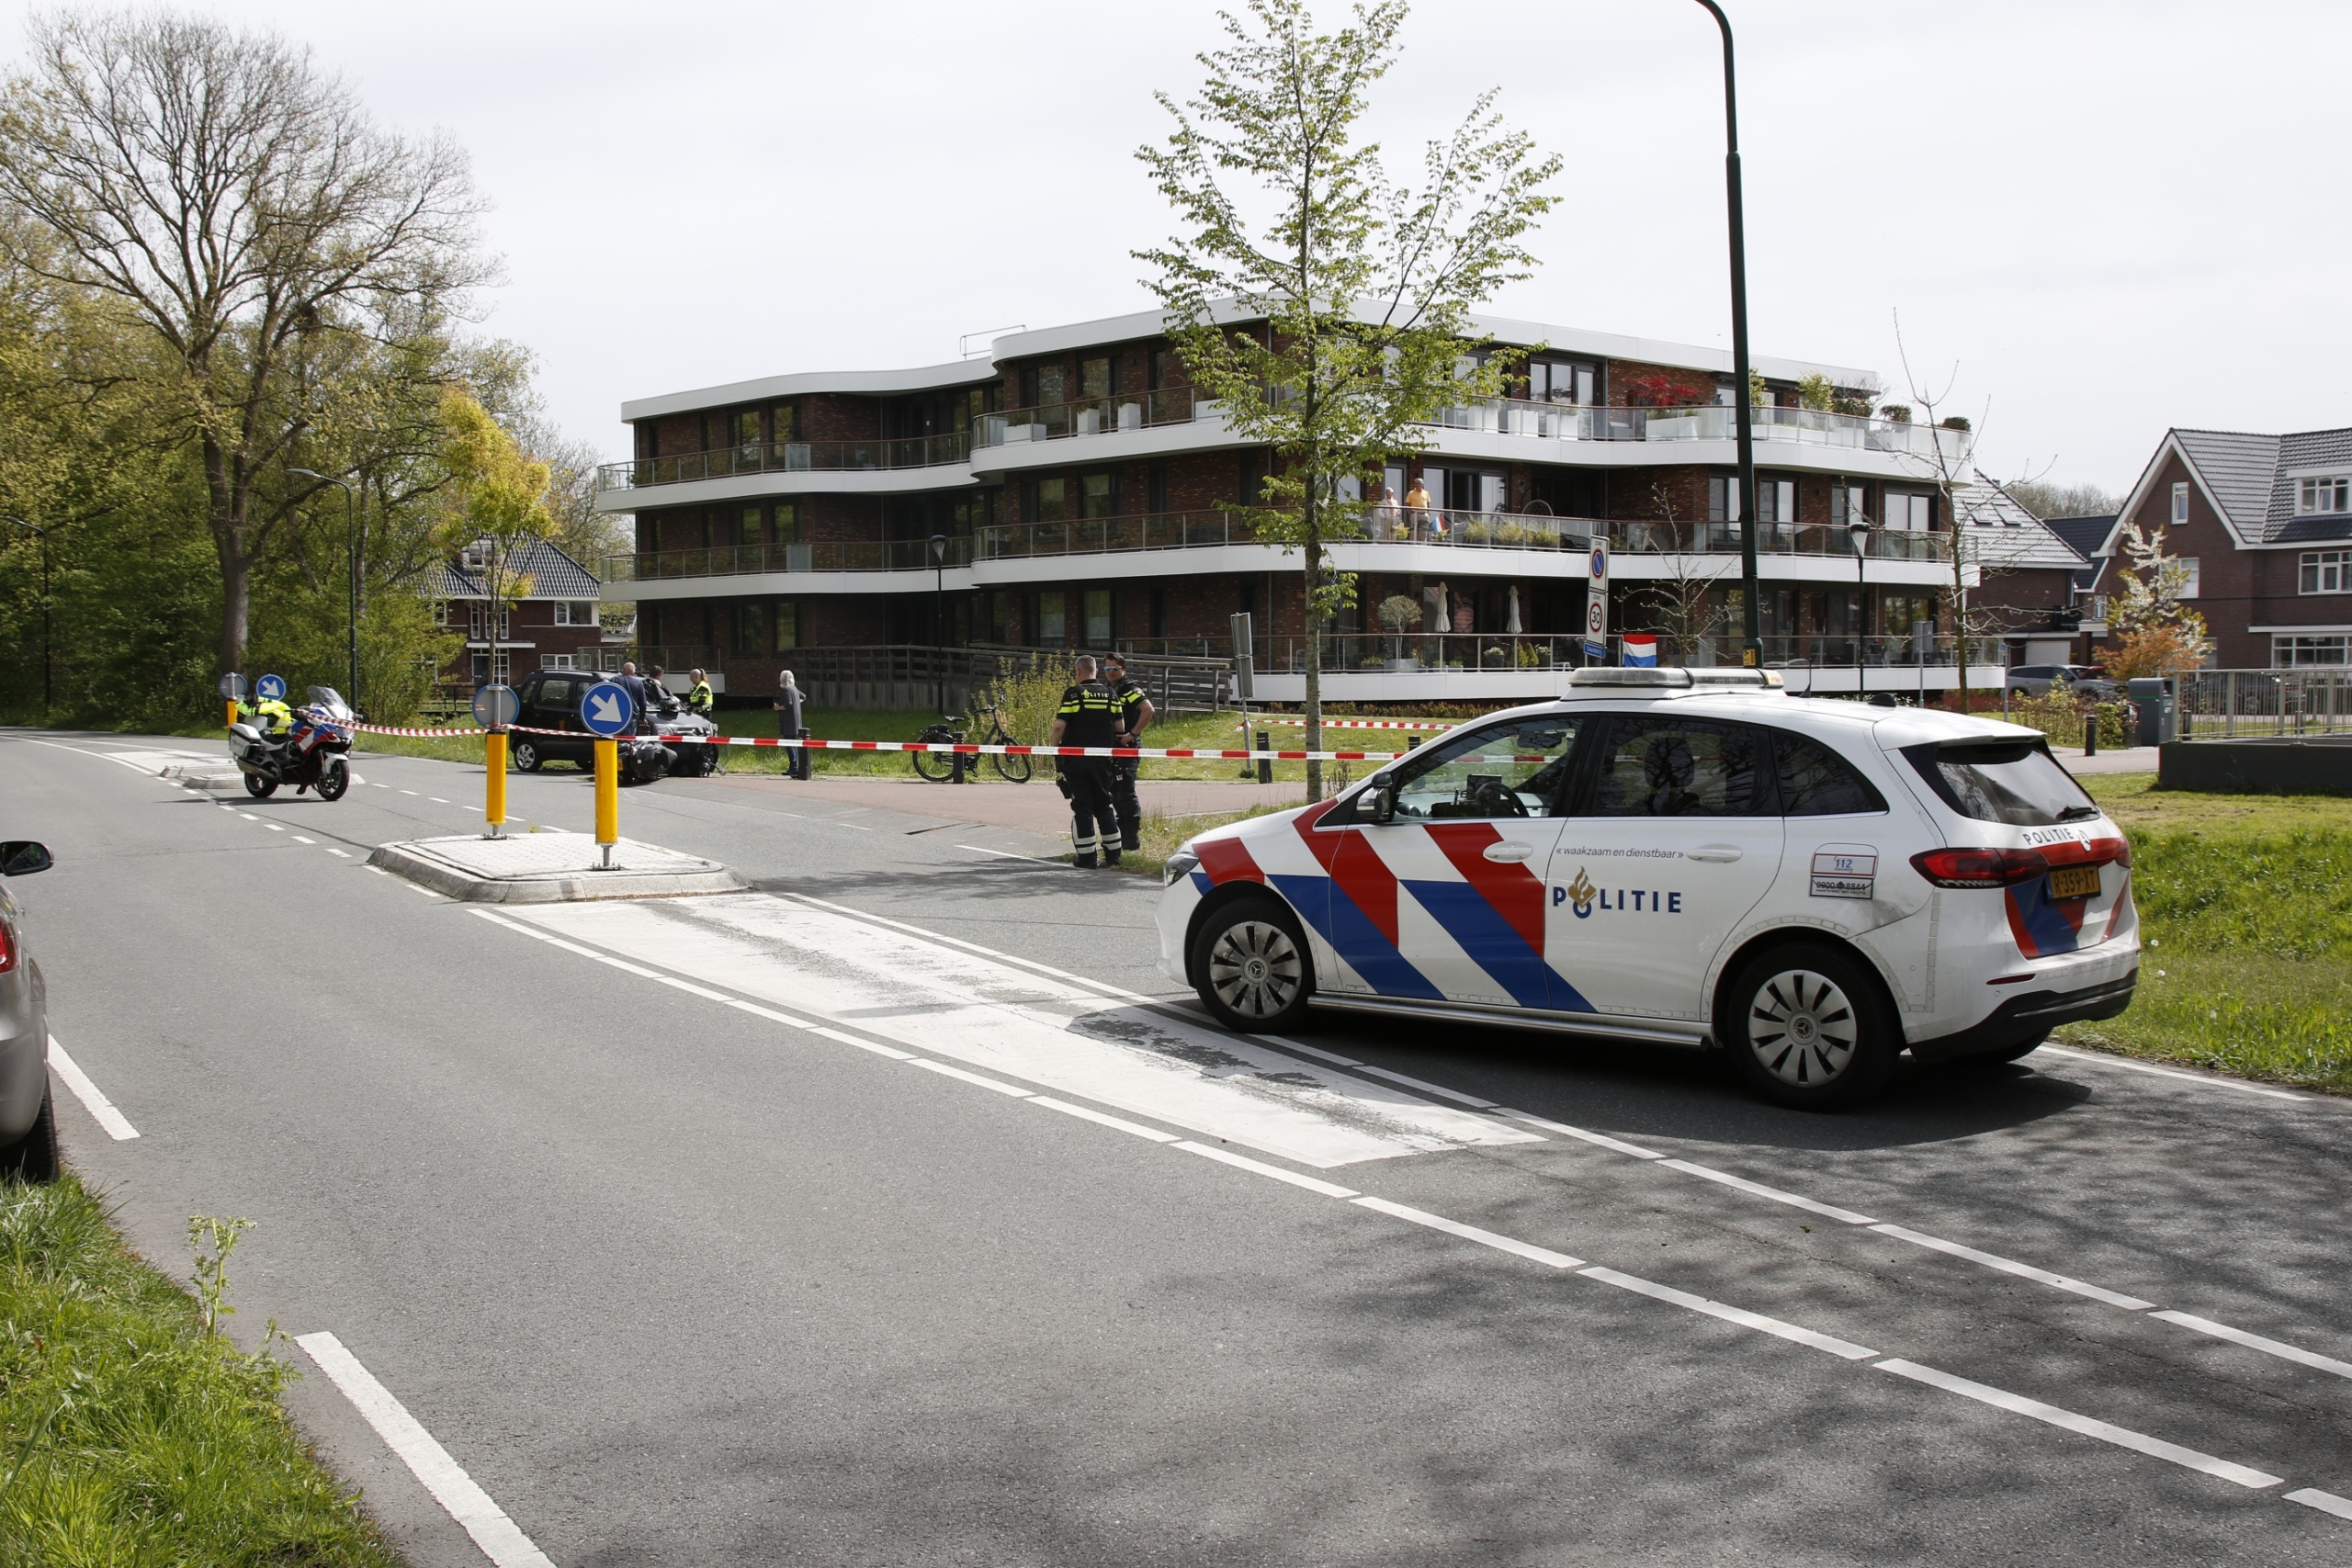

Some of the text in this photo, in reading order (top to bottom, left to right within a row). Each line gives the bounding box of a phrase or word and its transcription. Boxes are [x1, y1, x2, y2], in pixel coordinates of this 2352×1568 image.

[1591, 611, 1600, 625] 30
[2022, 828, 2074, 845] POLITIE
[1564, 846, 1611, 856] waakzaam
[1612, 849, 1624, 857] en
[1625, 847, 1676, 858] dienstbaar
[1553, 886, 1681, 919] POLITIE
